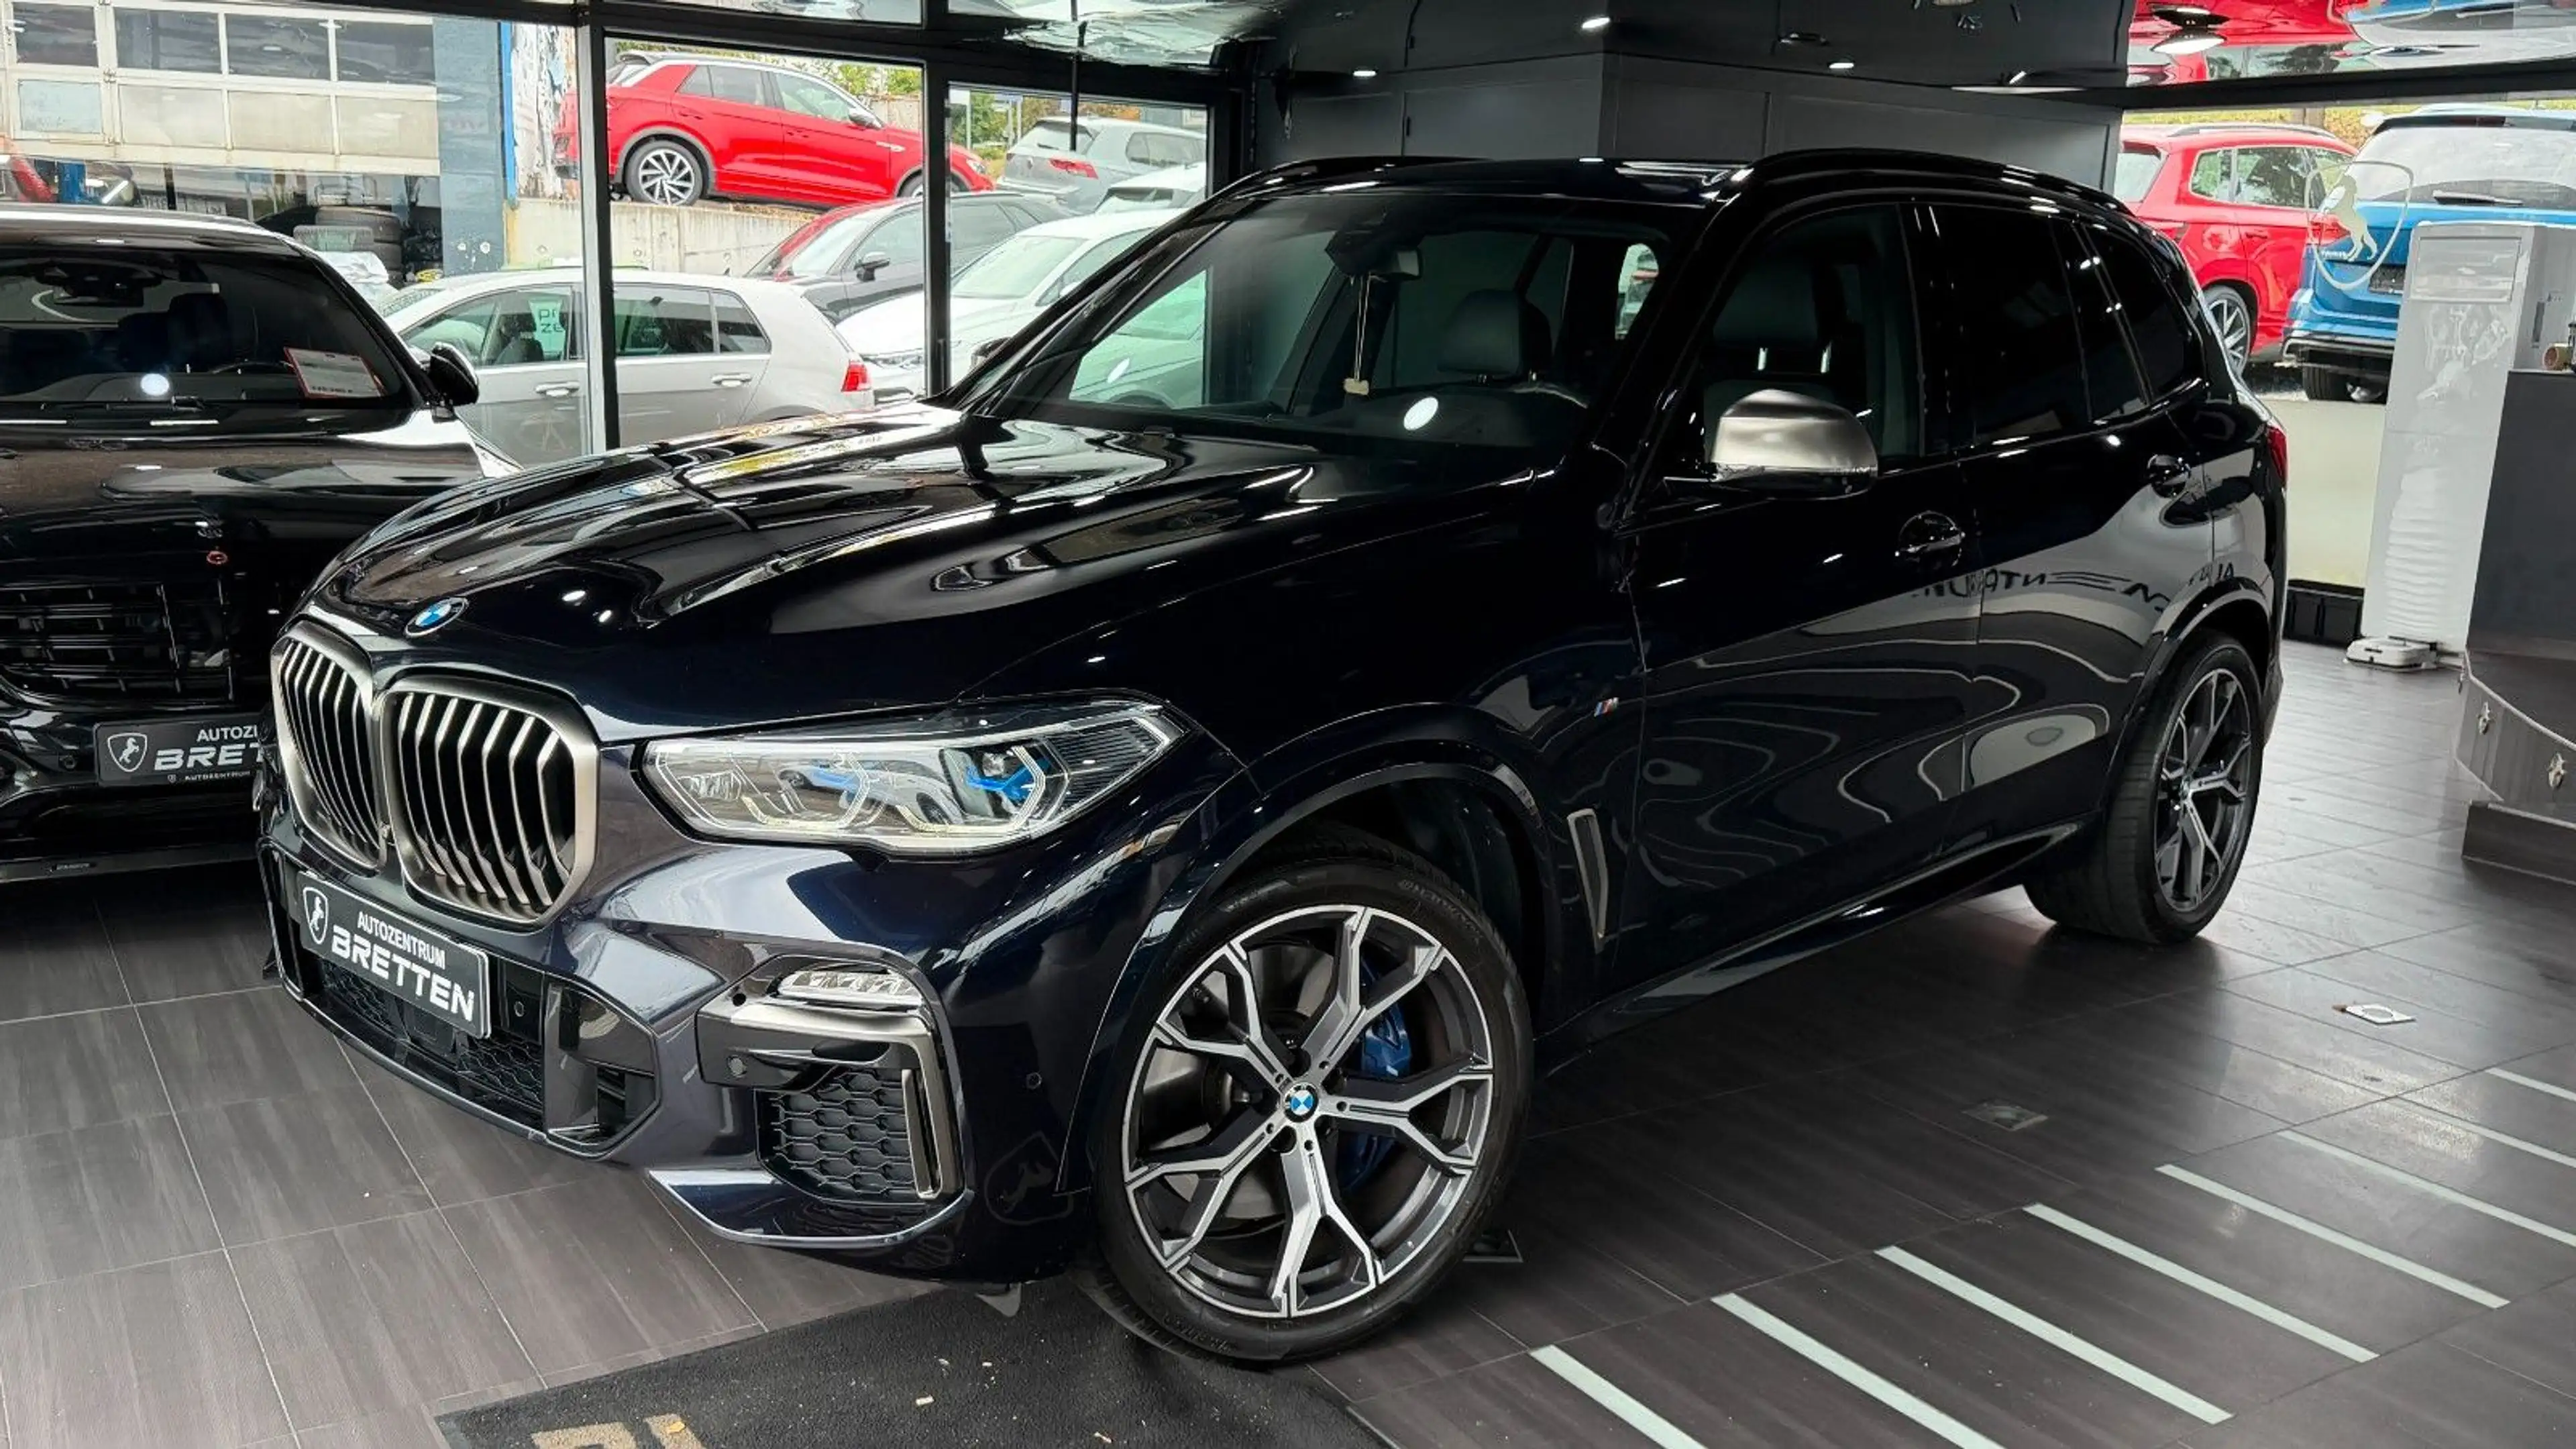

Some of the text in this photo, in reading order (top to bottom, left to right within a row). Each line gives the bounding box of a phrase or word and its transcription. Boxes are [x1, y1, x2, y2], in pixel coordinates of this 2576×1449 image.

[196, 724, 258, 742] AUTOZ
[357, 911, 446, 970] AUTOZENTRUM
[331, 924, 475, 1022] BRETTEN
